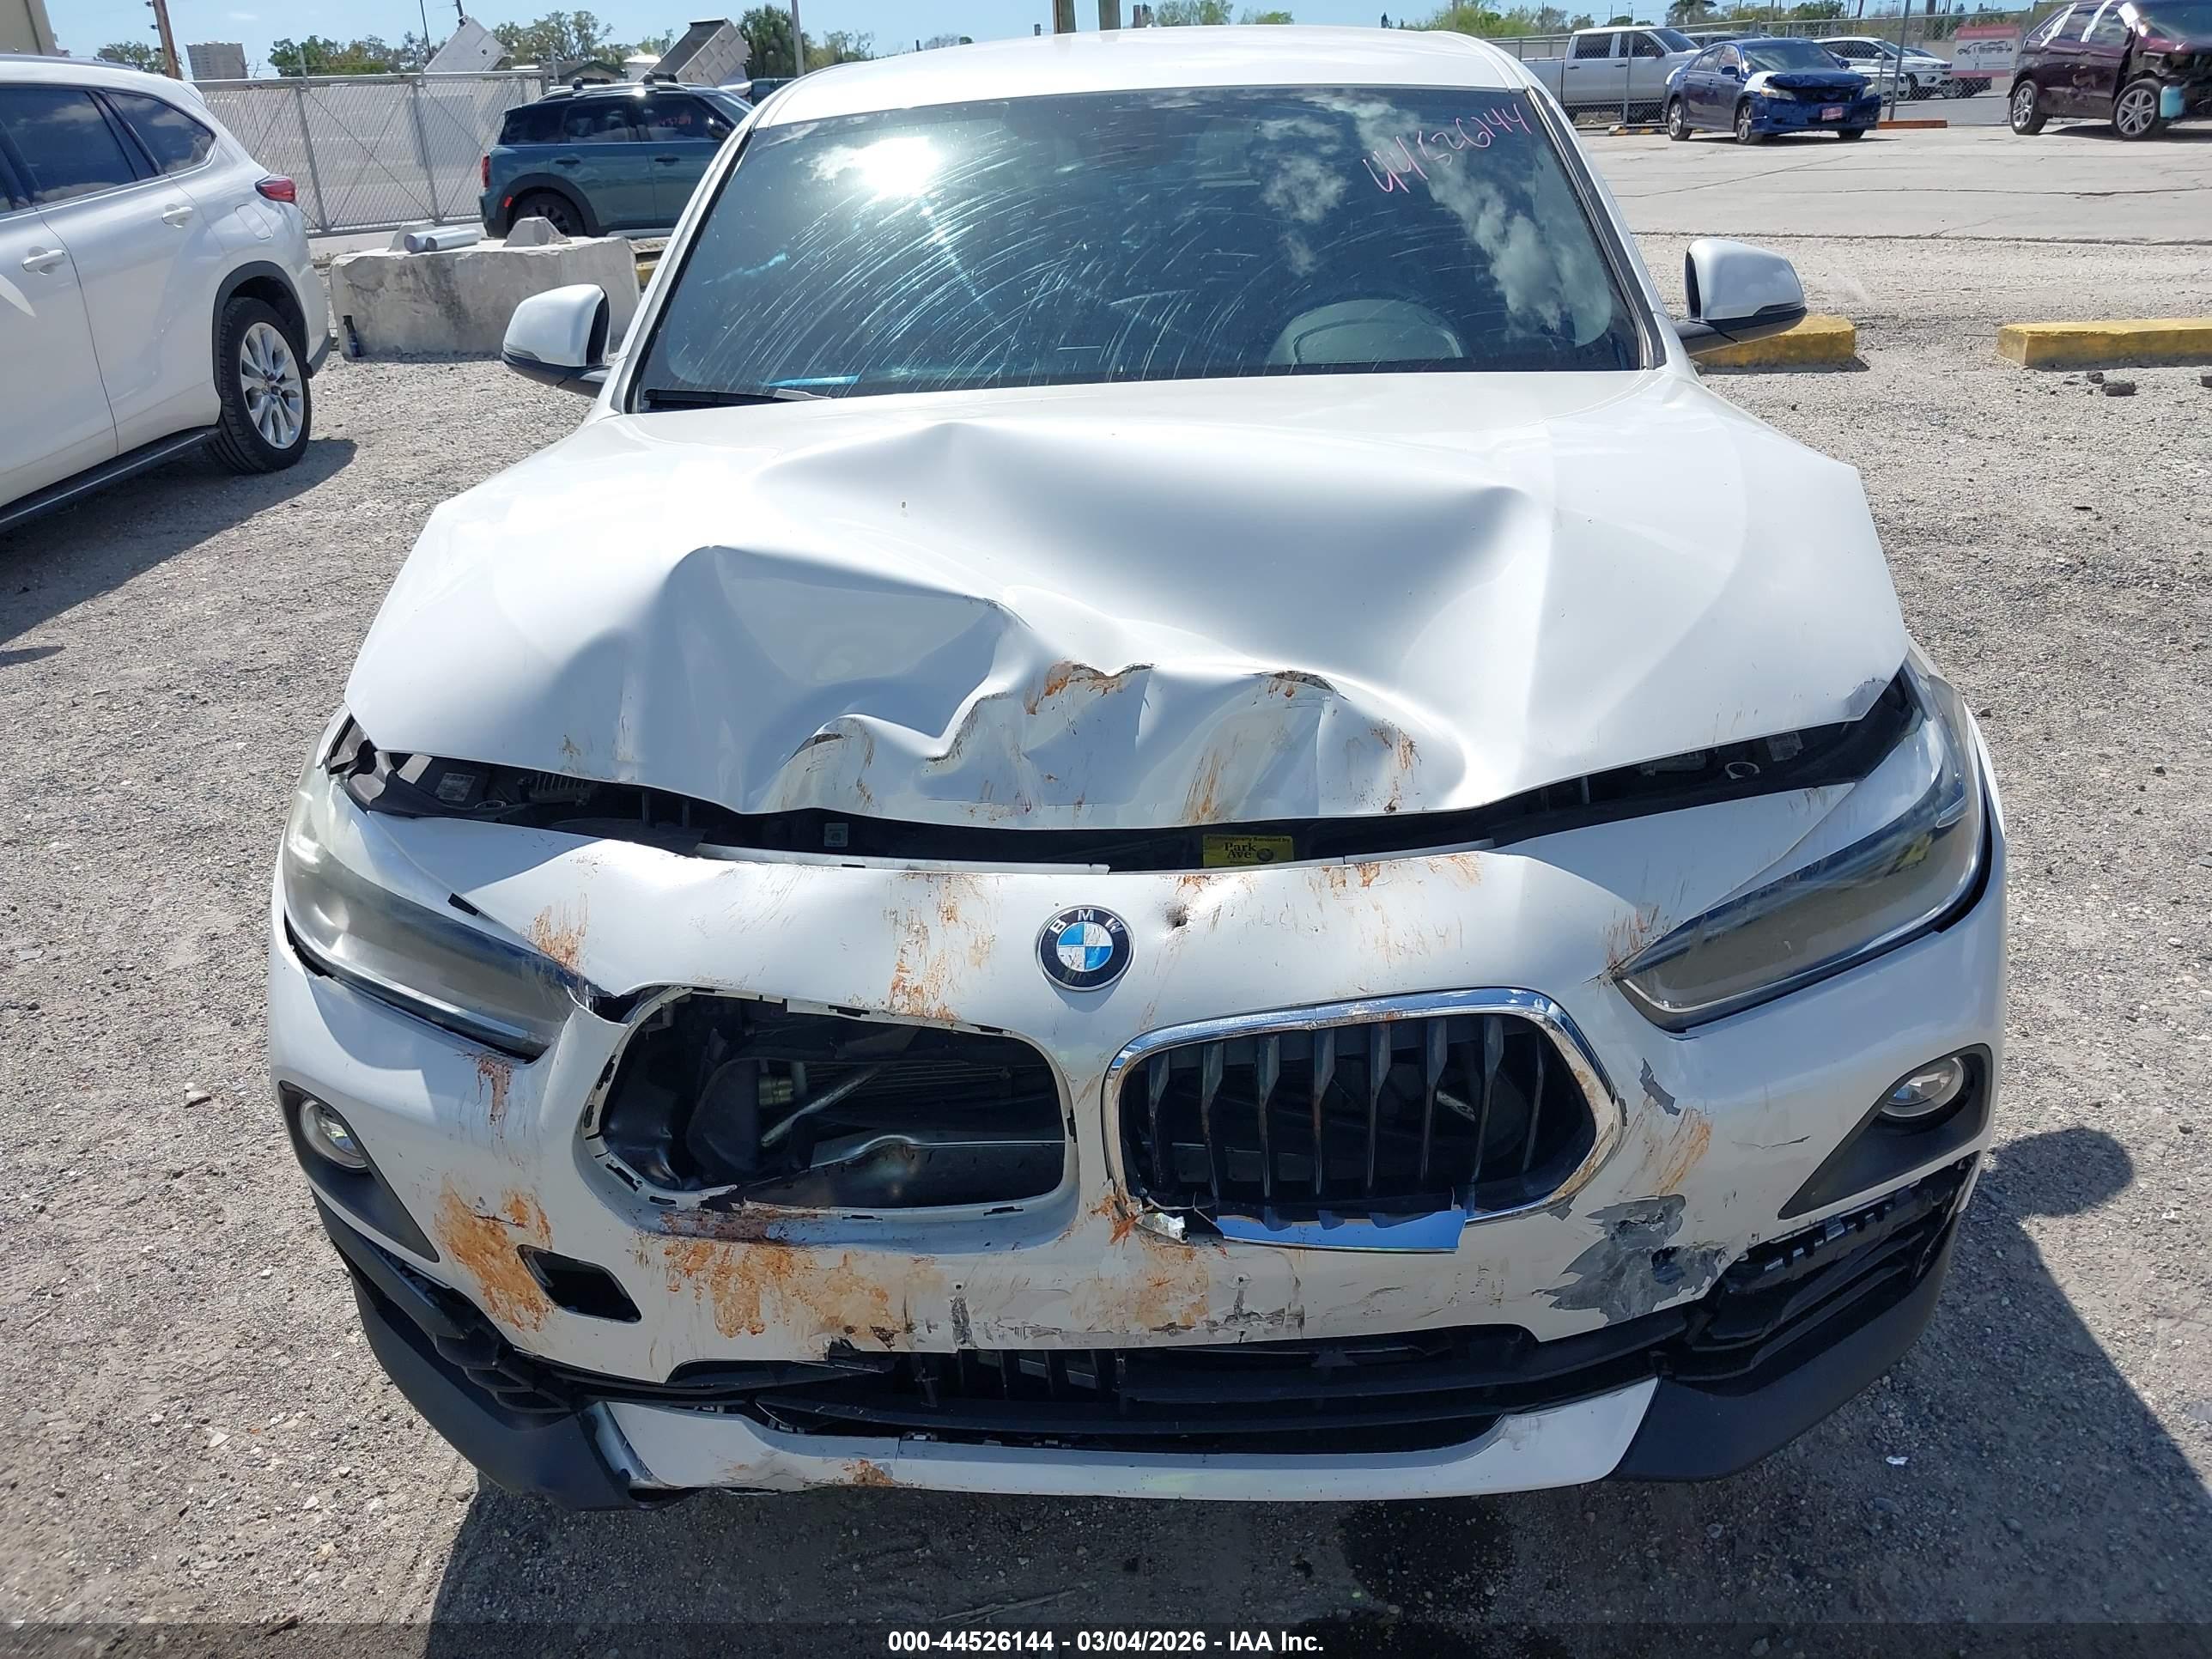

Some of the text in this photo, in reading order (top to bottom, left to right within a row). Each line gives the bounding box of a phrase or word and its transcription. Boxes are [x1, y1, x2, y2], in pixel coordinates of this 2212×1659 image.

[1224, 842, 1257, 852] Park
[1227, 849, 1251, 859] Ave
[1049, 909, 1124, 934] BMW
